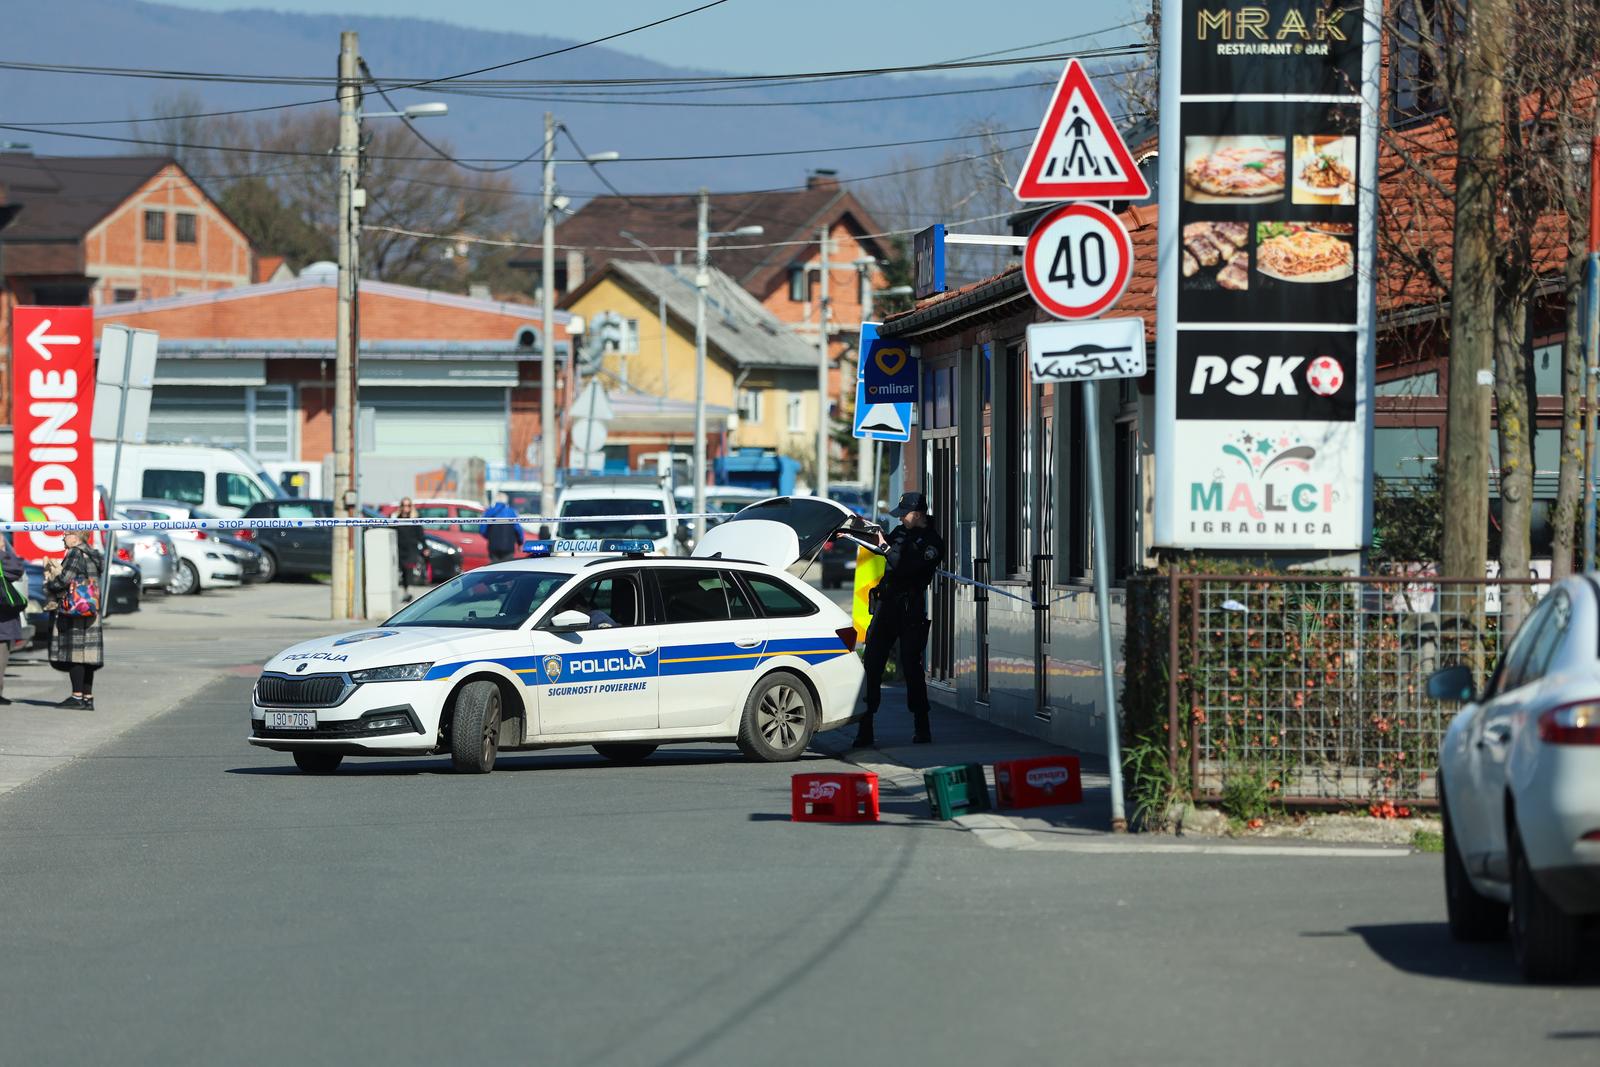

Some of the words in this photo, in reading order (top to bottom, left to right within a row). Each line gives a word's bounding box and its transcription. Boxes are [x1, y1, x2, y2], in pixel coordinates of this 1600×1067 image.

[1198, 7, 1347, 40] MRAK
[1217, 43, 1292, 55] RESTAURANT
[1048, 231, 1107, 289] 40
[1189, 355, 1305, 396] PSK
[878, 383, 914, 395] mlinar
[1190, 482, 1333, 519] MALCI
[121, 522, 147, 530] STOP
[153, 521, 197, 530] POLICIJA
[218, 520, 244, 529] STOP
[250, 520, 293, 528] POLICIJA
[314, 519, 340, 527] STOP
[1190, 521, 1332, 534] IGRAONICA
[556, 540, 598, 552] POLICIJA
[282, 652, 348, 662] POLICIJA
[569, 656, 646, 675] POLICIJA
[548, 686, 593, 696] SIGURNOST
[594, 685, 598, 694] I
[599, 681, 647, 693] POVJERENJE
[273, 713, 287, 726] 190
[293, 713, 309, 726] 706
